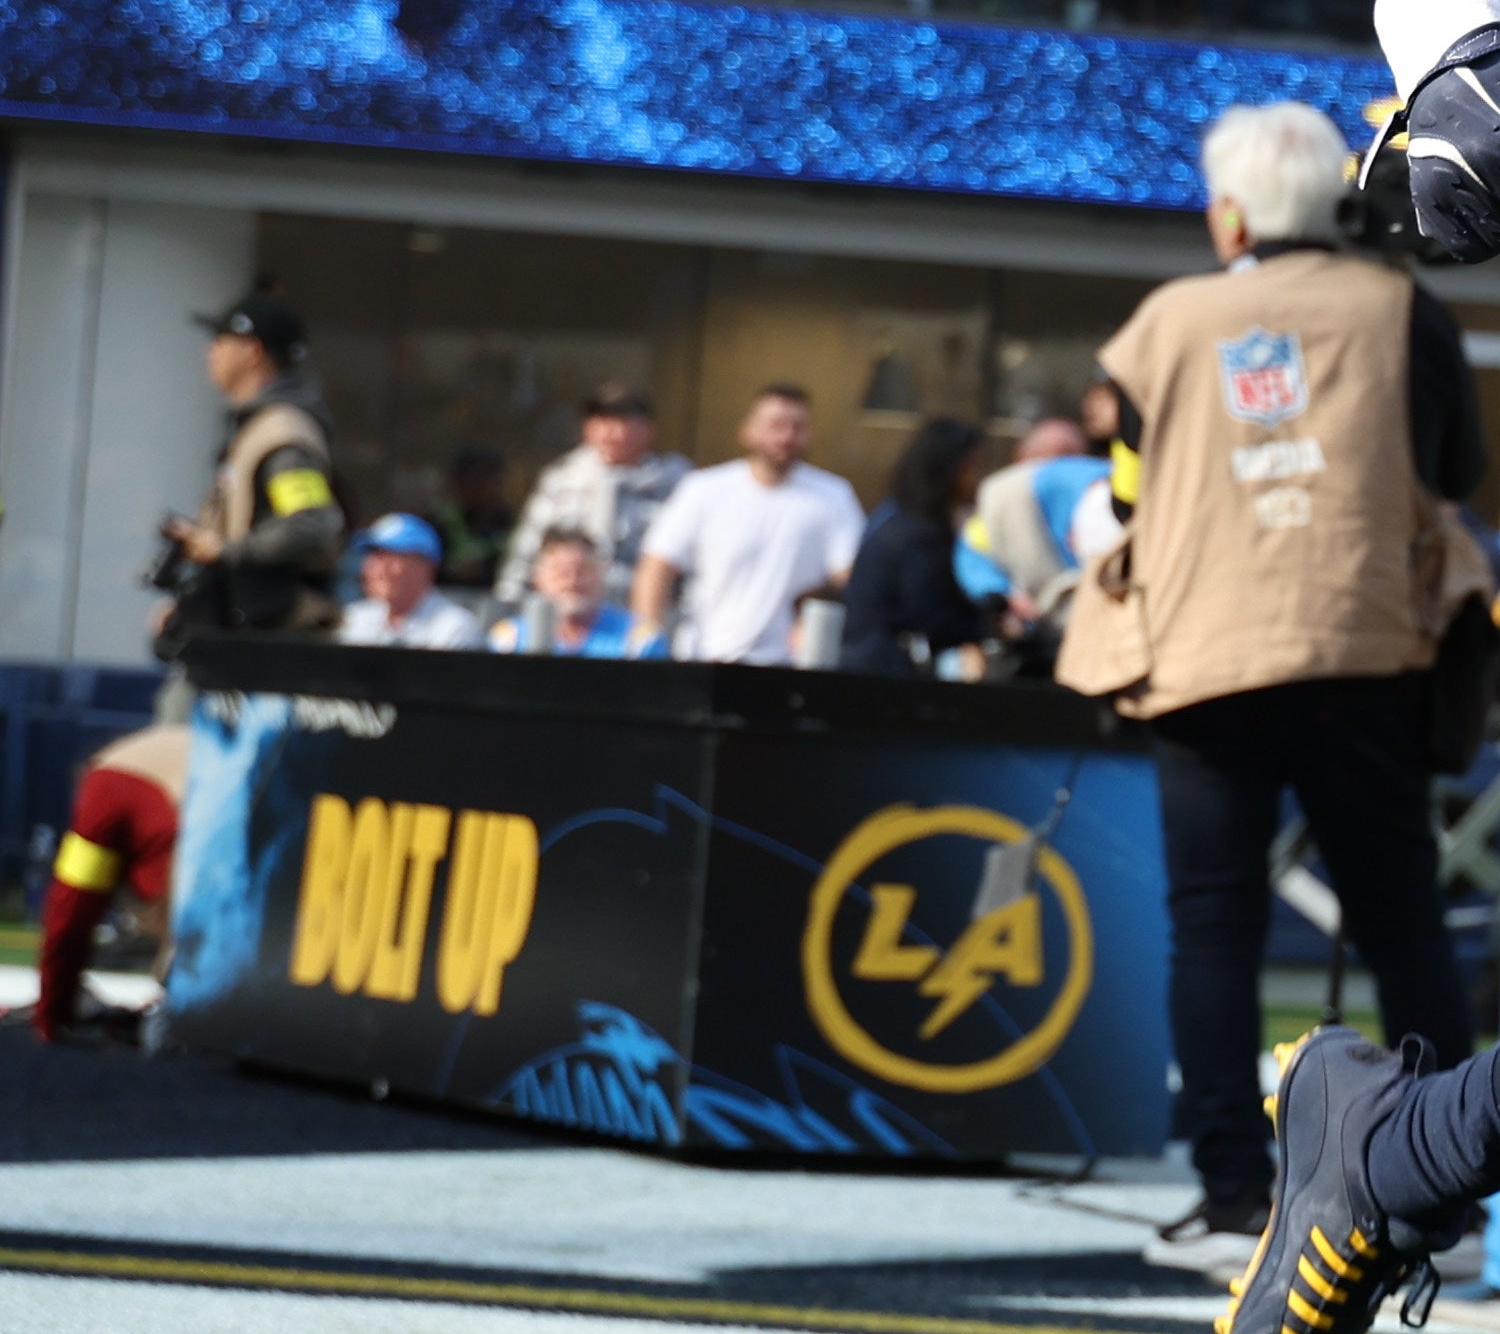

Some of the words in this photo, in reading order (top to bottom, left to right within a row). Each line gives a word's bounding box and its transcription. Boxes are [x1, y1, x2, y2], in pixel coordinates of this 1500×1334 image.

[289, 792, 453, 1003] BOLT
[436, 807, 540, 1018] UP
[851, 882, 1046, 1043] LA
